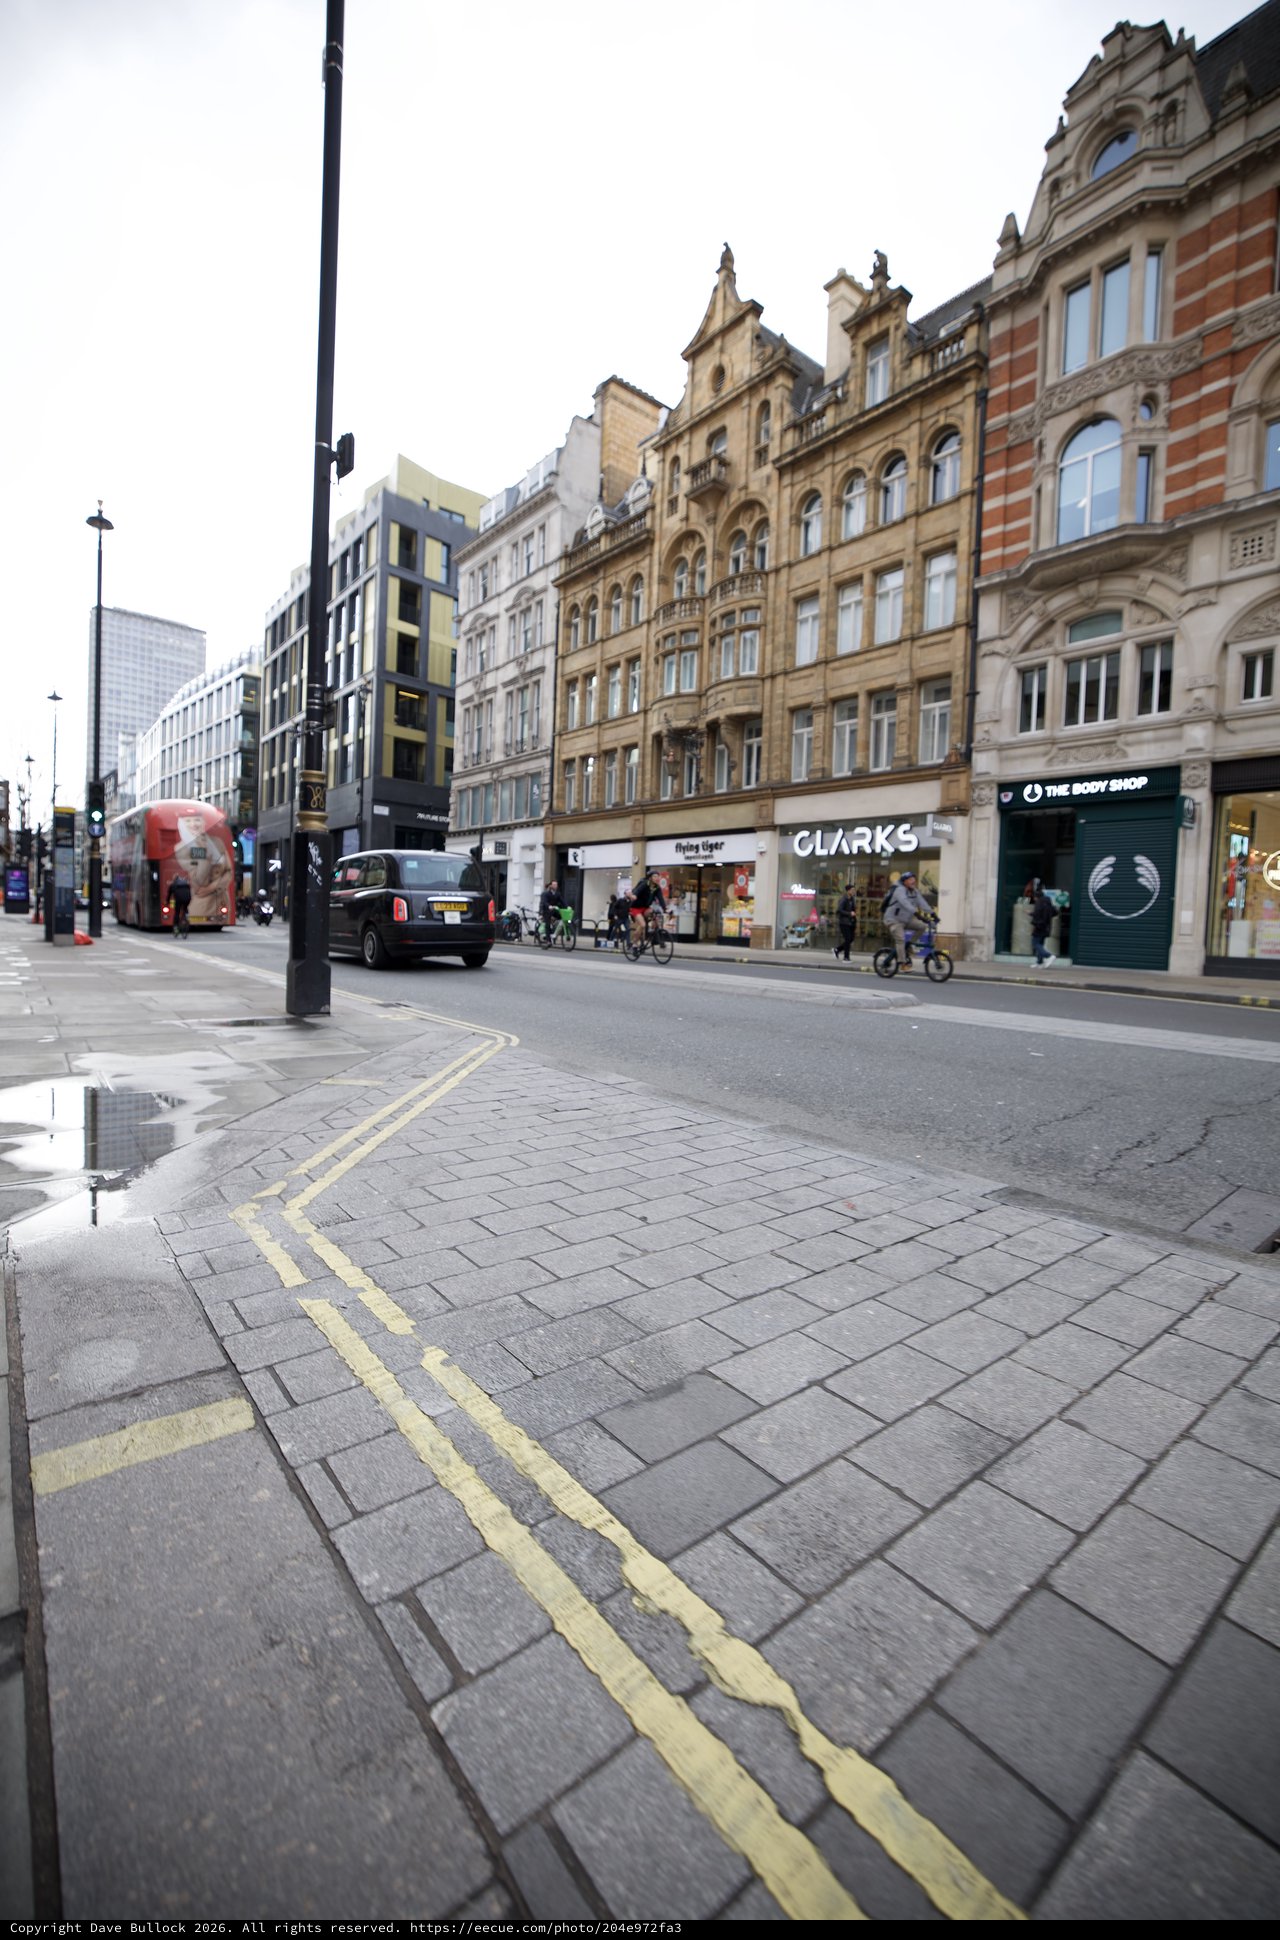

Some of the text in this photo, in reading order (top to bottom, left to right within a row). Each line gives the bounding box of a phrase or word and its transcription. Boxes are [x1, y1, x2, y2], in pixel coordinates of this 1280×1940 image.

[1045, 775, 1149, 797] THE BODY SHOP
[933, 821, 953, 833] CLARKS
[675, 840, 725, 854] flying tiger
[793, 823, 919, 857] CLARKS
